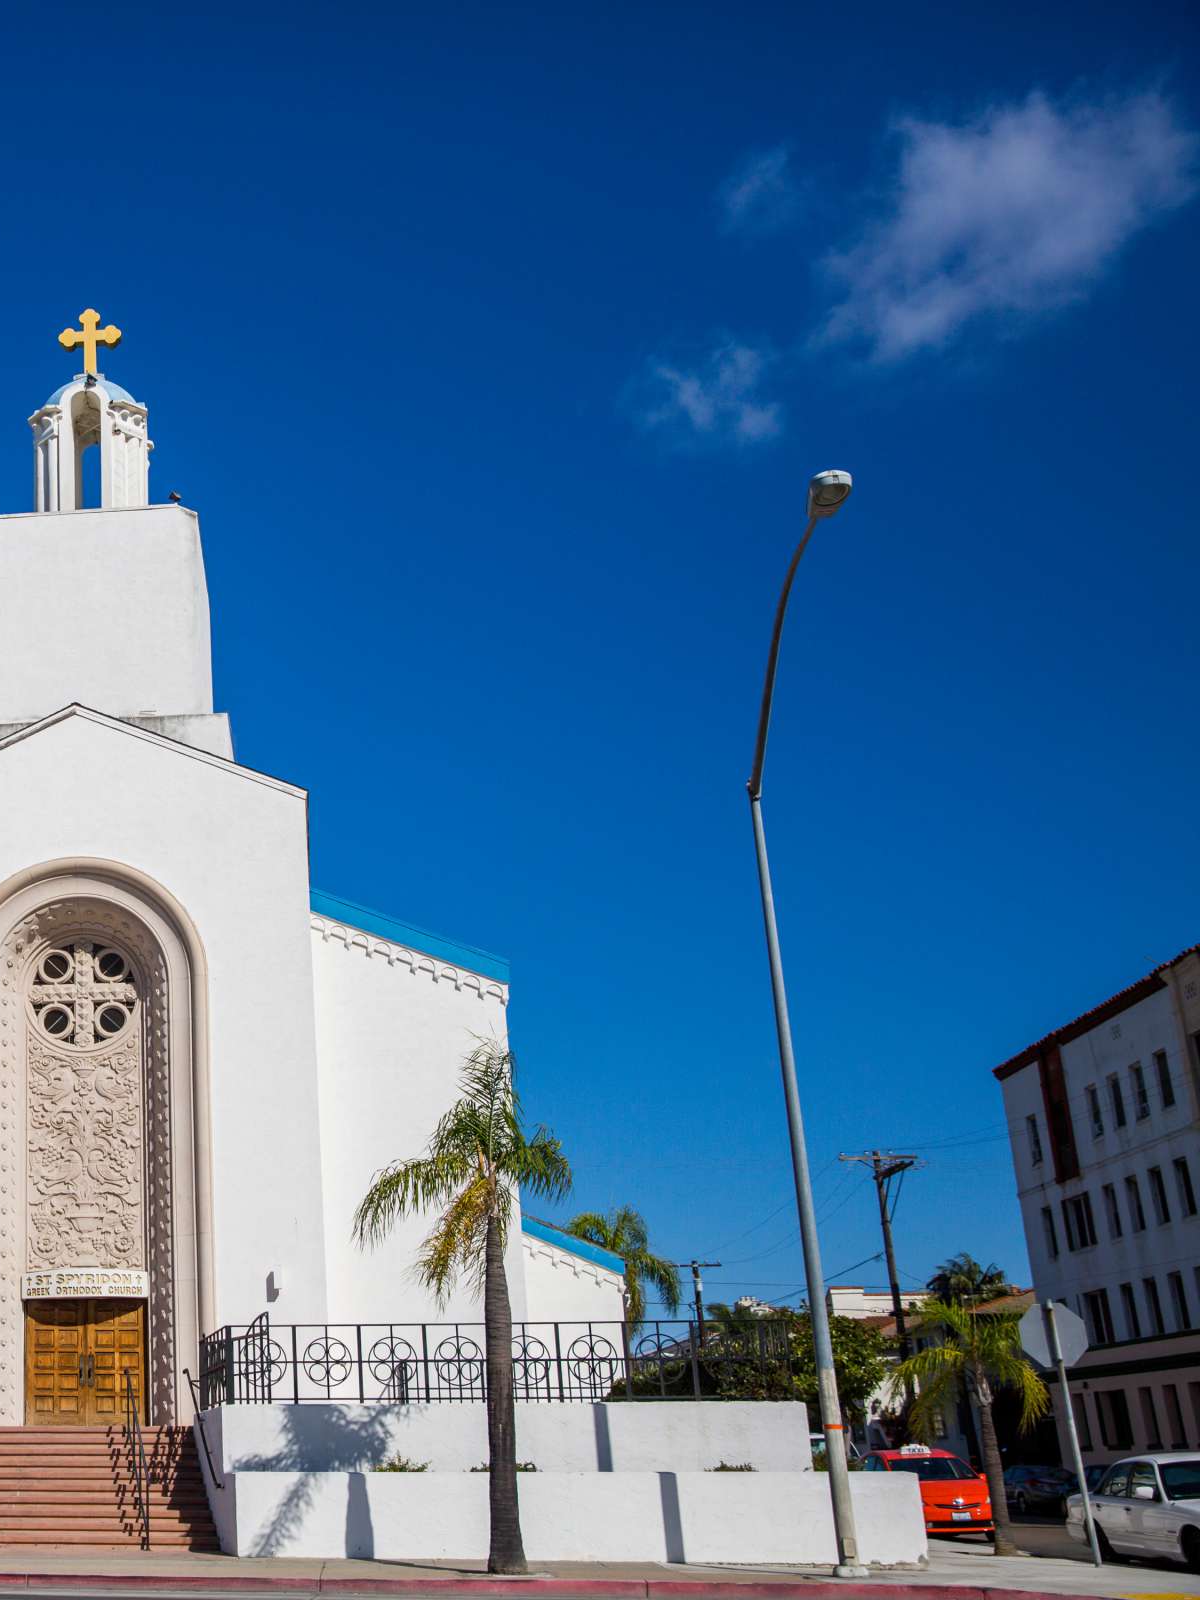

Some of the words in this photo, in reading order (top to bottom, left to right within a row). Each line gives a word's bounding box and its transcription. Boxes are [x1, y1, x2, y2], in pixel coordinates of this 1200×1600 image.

[35, 1274, 53, 1286] ST.
[56, 1273, 132, 1284] SPYRIDON
[26, 1287, 50, 1297] GREEK
[56, 1286, 102, 1295] ORTHODOX
[108, 1286, 143, 1295] CHURCH
